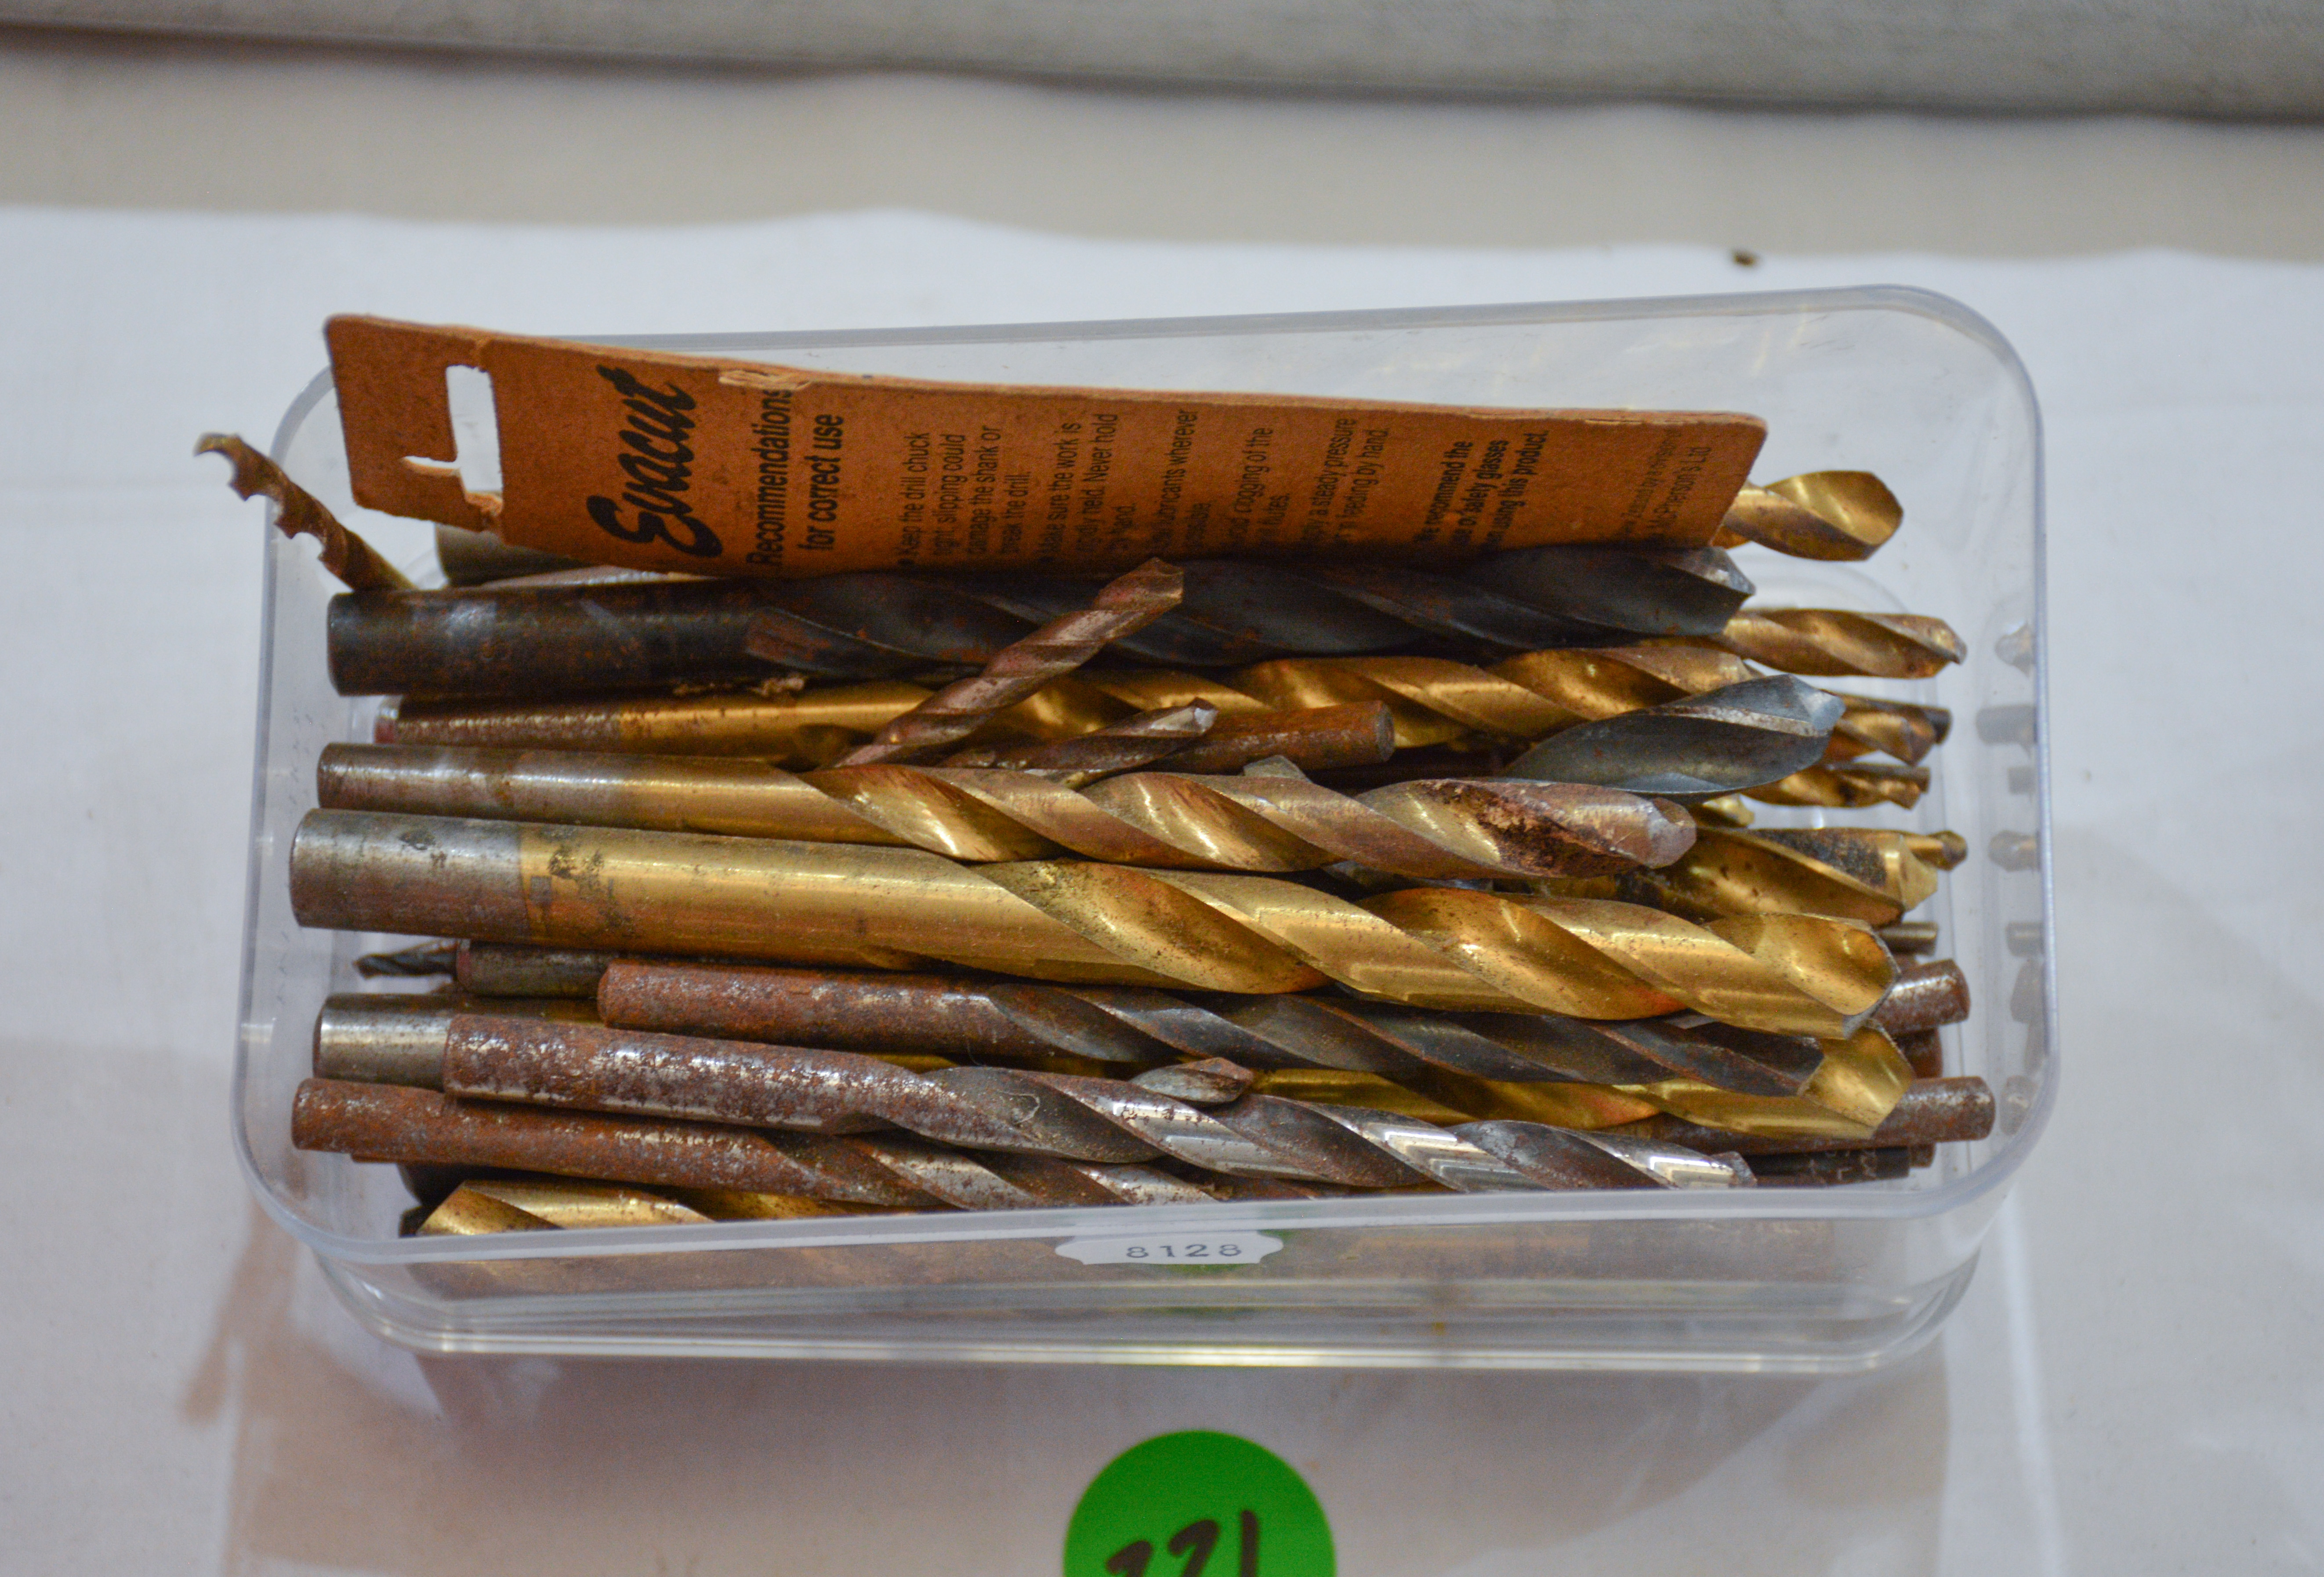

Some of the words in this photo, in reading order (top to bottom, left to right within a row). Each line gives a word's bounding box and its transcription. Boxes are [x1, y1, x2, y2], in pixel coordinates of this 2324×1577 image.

[814, 413, 845, 451] use
[981, 425, 1001, 441] or
[1055, 422, 1081, 433] is
[1091, 413, 1118, 442] hold
[1165, 409, 1197, 465] wherever
[1246, 427, 1273, 447] the
[1325, 418, 1358, 466] pressure
[903, 432, 929, 472] chuck
[938, 433, 965, 470] could
[972, 446, 1000, 482] shank
[1053, 439, 1078, 468] work
[1083, 447, 1113, 481] Never
[1241, 450, 1267, 461] of
[1443, 441, 1473, 458] the
[1472, 440, 1509, 479] glasses
[1512, 430, 1550, 475] product.
[746, 390, 792, 565] Recommendations
[1048, 472, 1073, 491] the
[1351, 461, 1384, 475] by
[805, 455, 841, 523] correct
[900, 476, 926, 499] drill
[969, 486, 994, 505] the
[1004, 471, 1031, 496] drill.
[1233, 465, 1270, 512] clogging
[1311, 469, 1347, 505] steady
[1424, 461, 1465, 524] recommend
[1461, 482, 1499, 512] safety
[1498, 478, 1529, 496] this
[899, 503, 924, 522] the
[932, 475, 968, 523] slipping
[1002, 501, 1026, 518] the
[1048, 494, 1070, 519] sure
[798, 526, 834, 551] for
[1126, 1244, 1242, 1258] 8128
